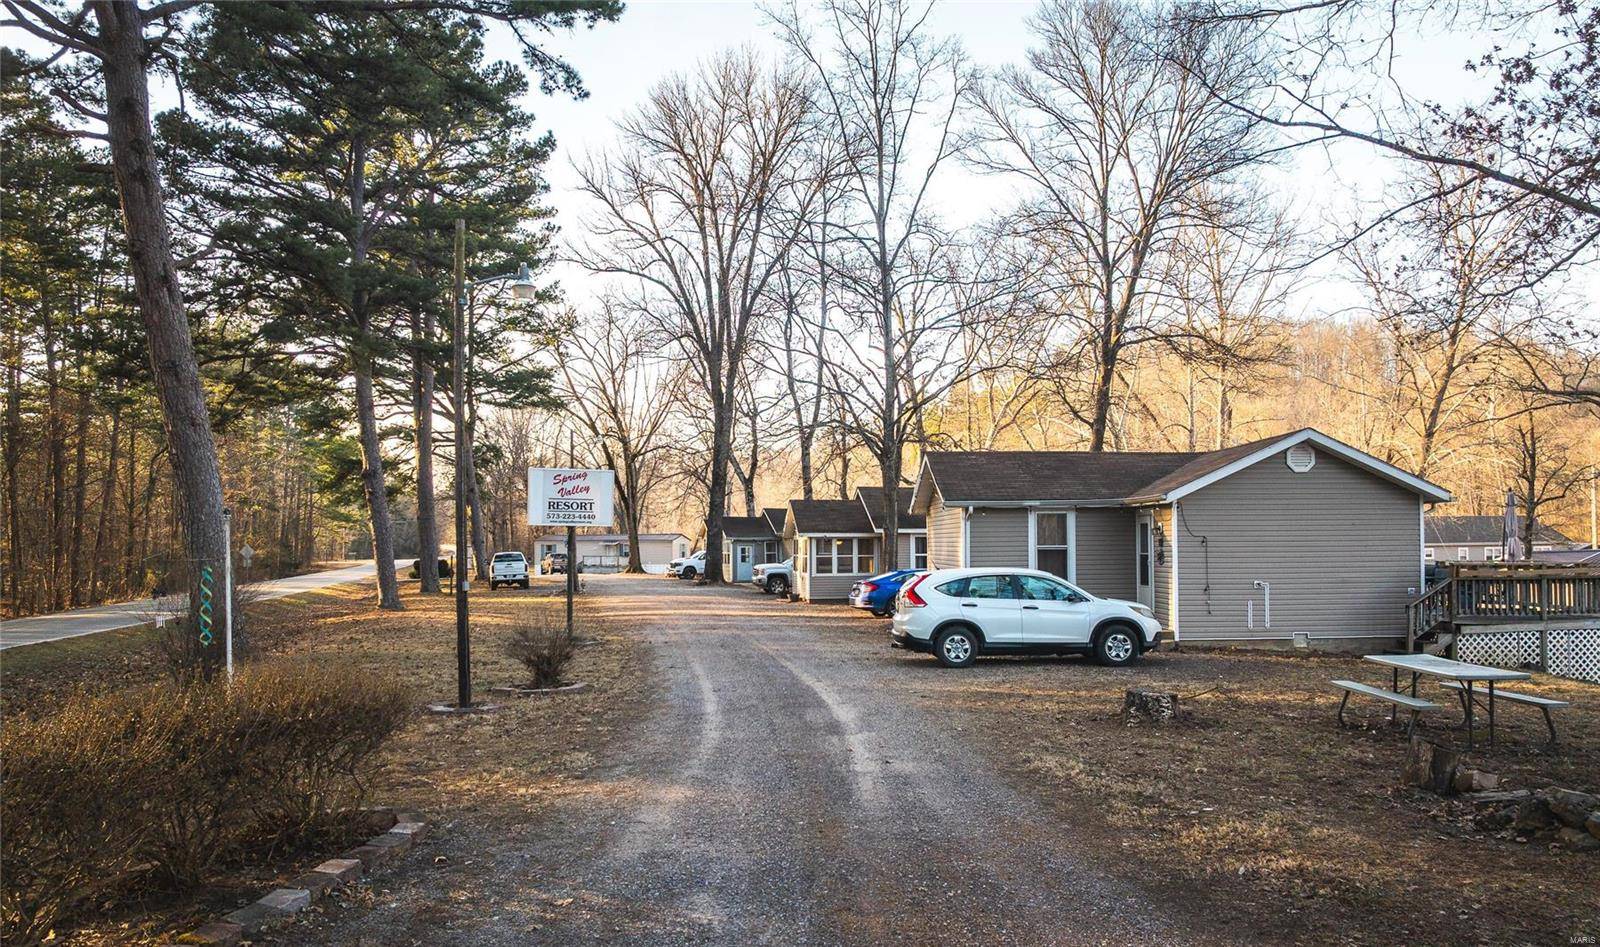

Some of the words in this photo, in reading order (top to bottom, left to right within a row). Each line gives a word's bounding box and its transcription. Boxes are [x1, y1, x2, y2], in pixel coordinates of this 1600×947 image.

[553, 472, 588, 485] Spring
[557, 485, 591, 497] Valley
[547, 501, 595, 511] RESORT
